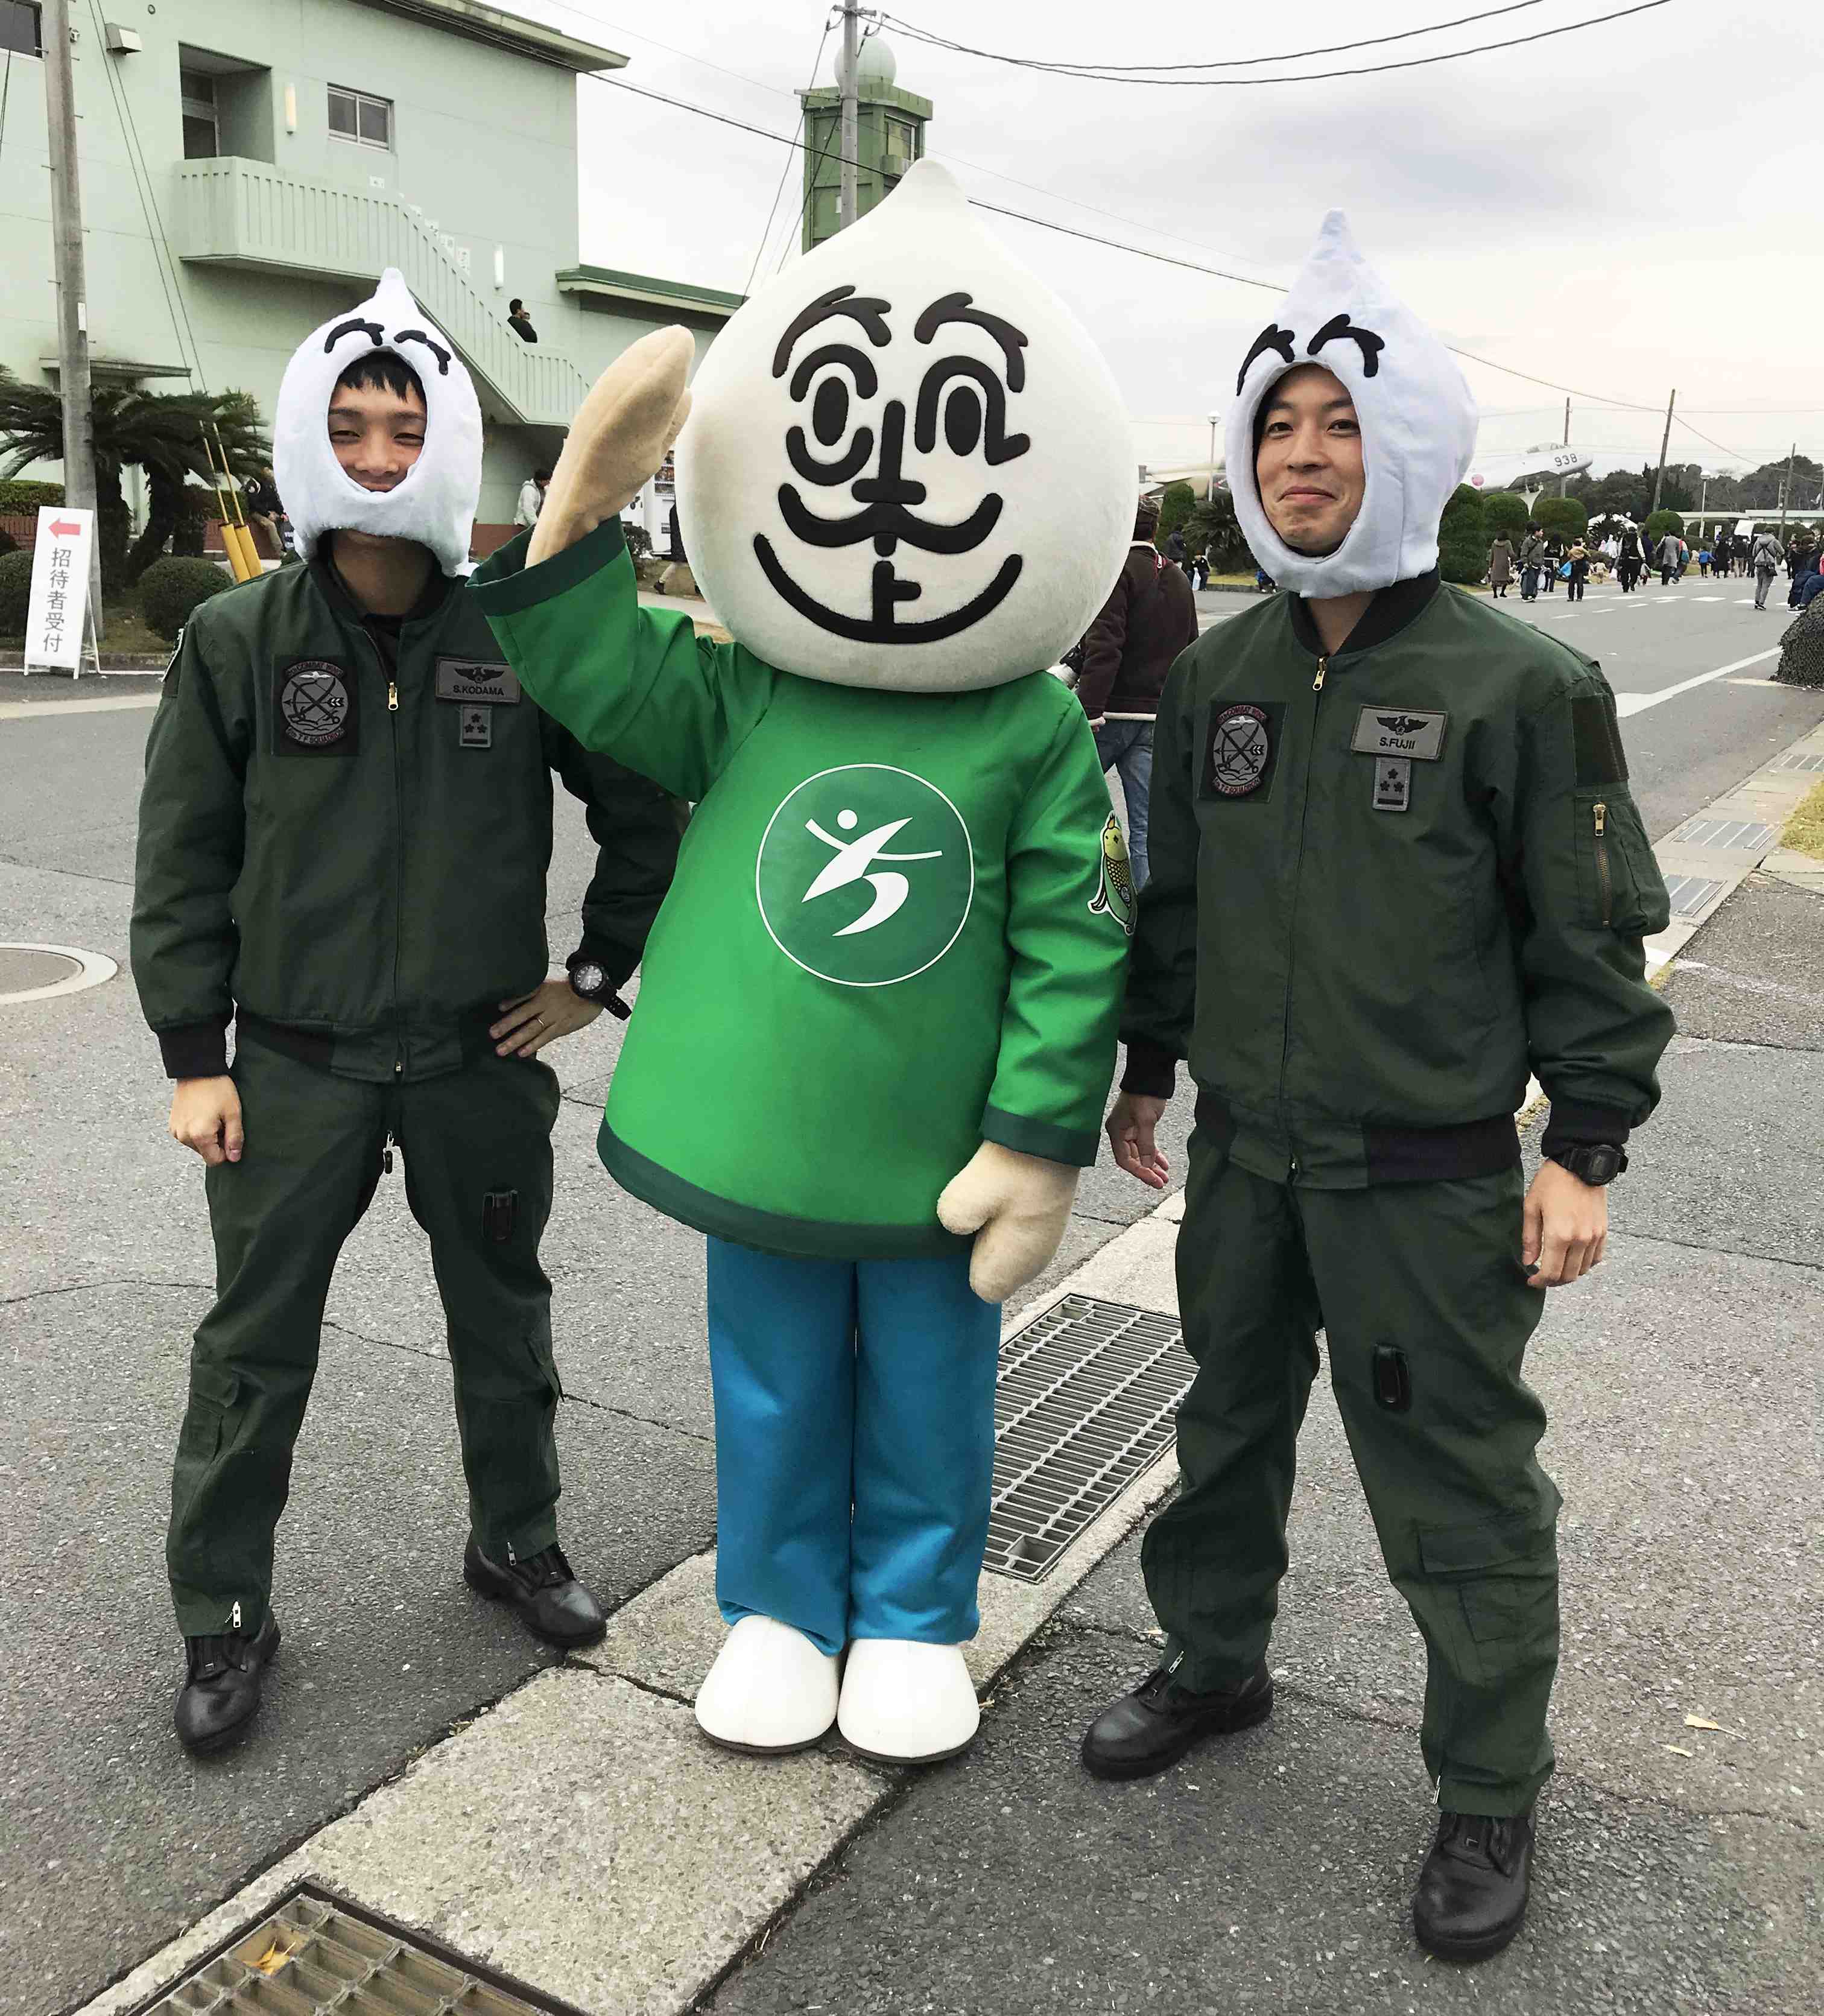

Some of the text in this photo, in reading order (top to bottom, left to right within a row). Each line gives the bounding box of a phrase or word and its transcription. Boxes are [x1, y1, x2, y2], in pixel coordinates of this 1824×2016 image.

[1554, 453, 1578, 467] 938
[43, 547, 72, 653] 招待者受付
[453, 685, 504, 696] S.KODAMA
[1379, 737, 1416, 750] S.FUJII
